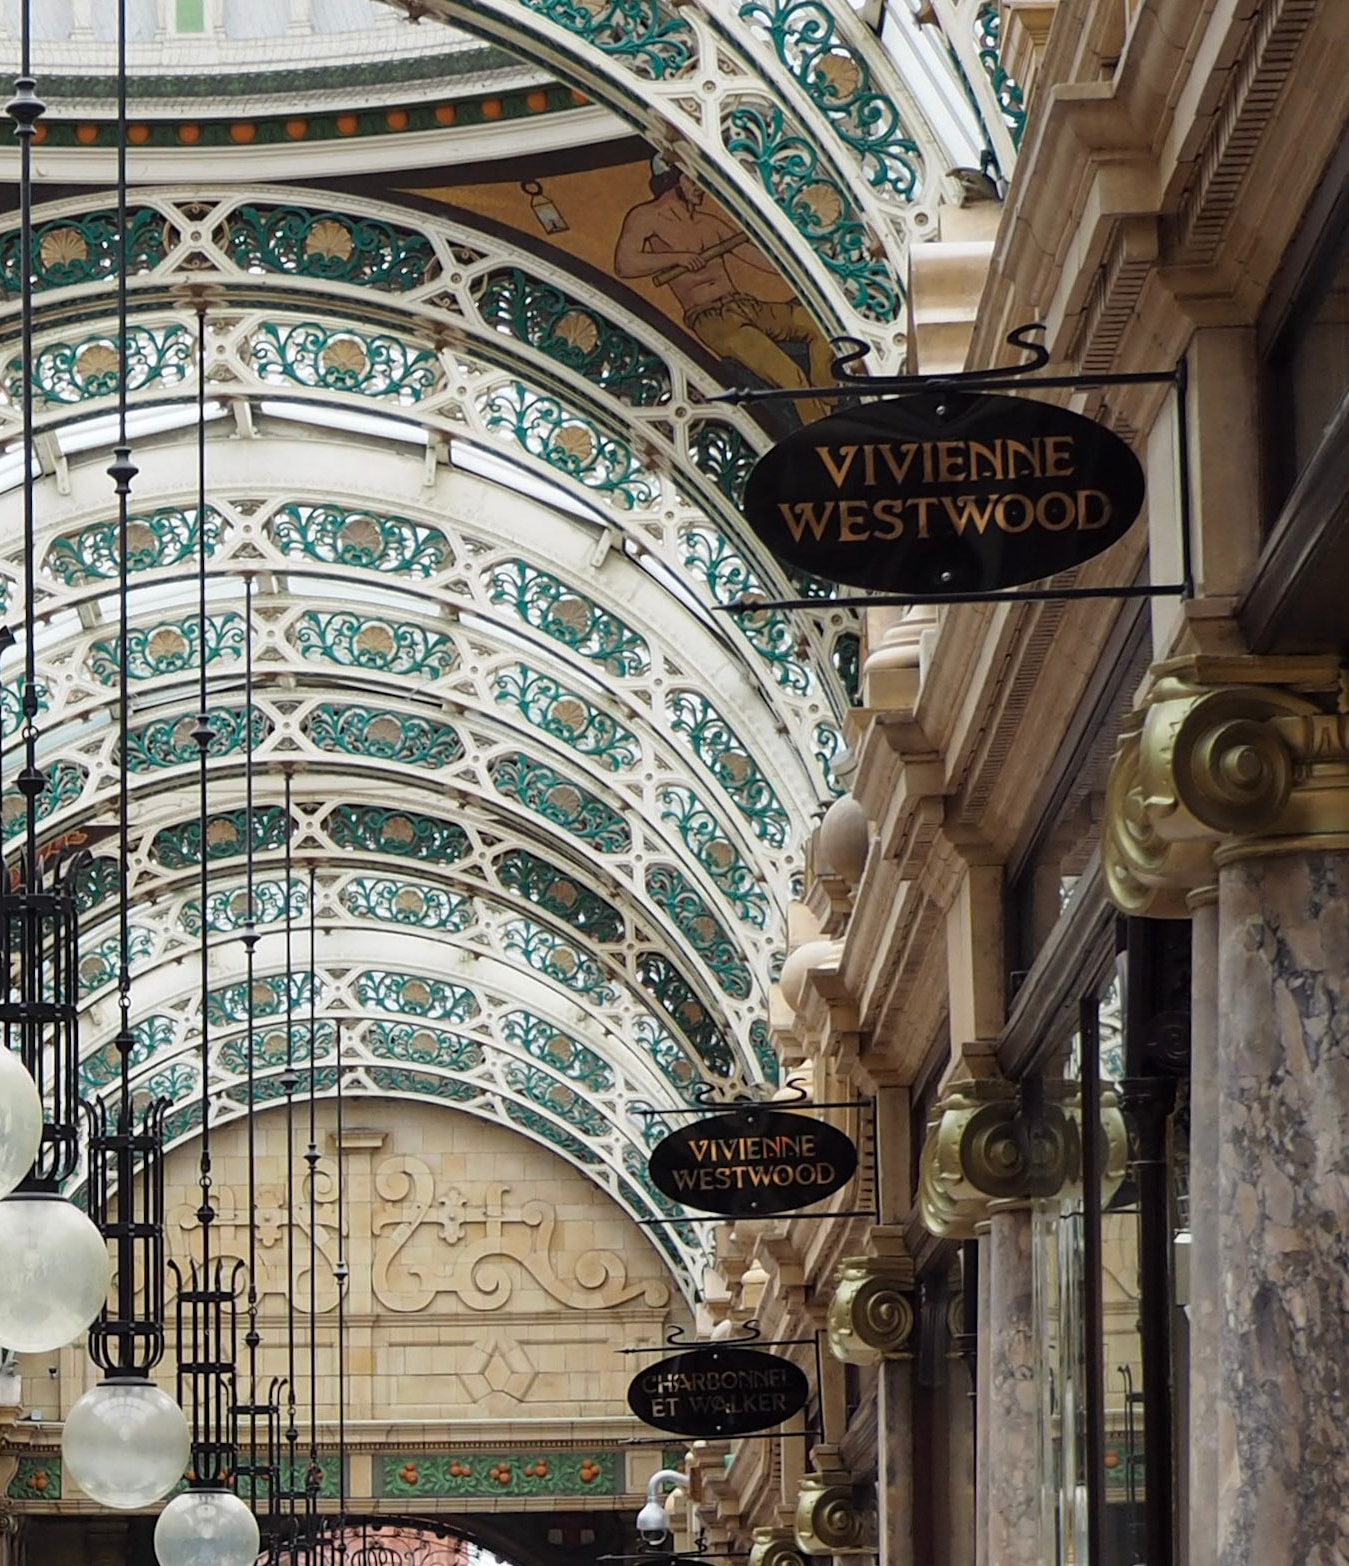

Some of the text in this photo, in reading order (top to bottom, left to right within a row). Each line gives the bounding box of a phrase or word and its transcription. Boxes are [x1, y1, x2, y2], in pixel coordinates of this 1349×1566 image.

[815, 436, 1075, 488] VIVIENNE
[777, 490, 1114, 543] WESTWOOD
[688, 1135, 816, 1162] VIVIENNE
[672, 1162, 835, 1192] WESTWOOD
[643, 1368, 792, 1394] CHARBONNEL
[652, 1393, 786, 1418] ET WALKER
